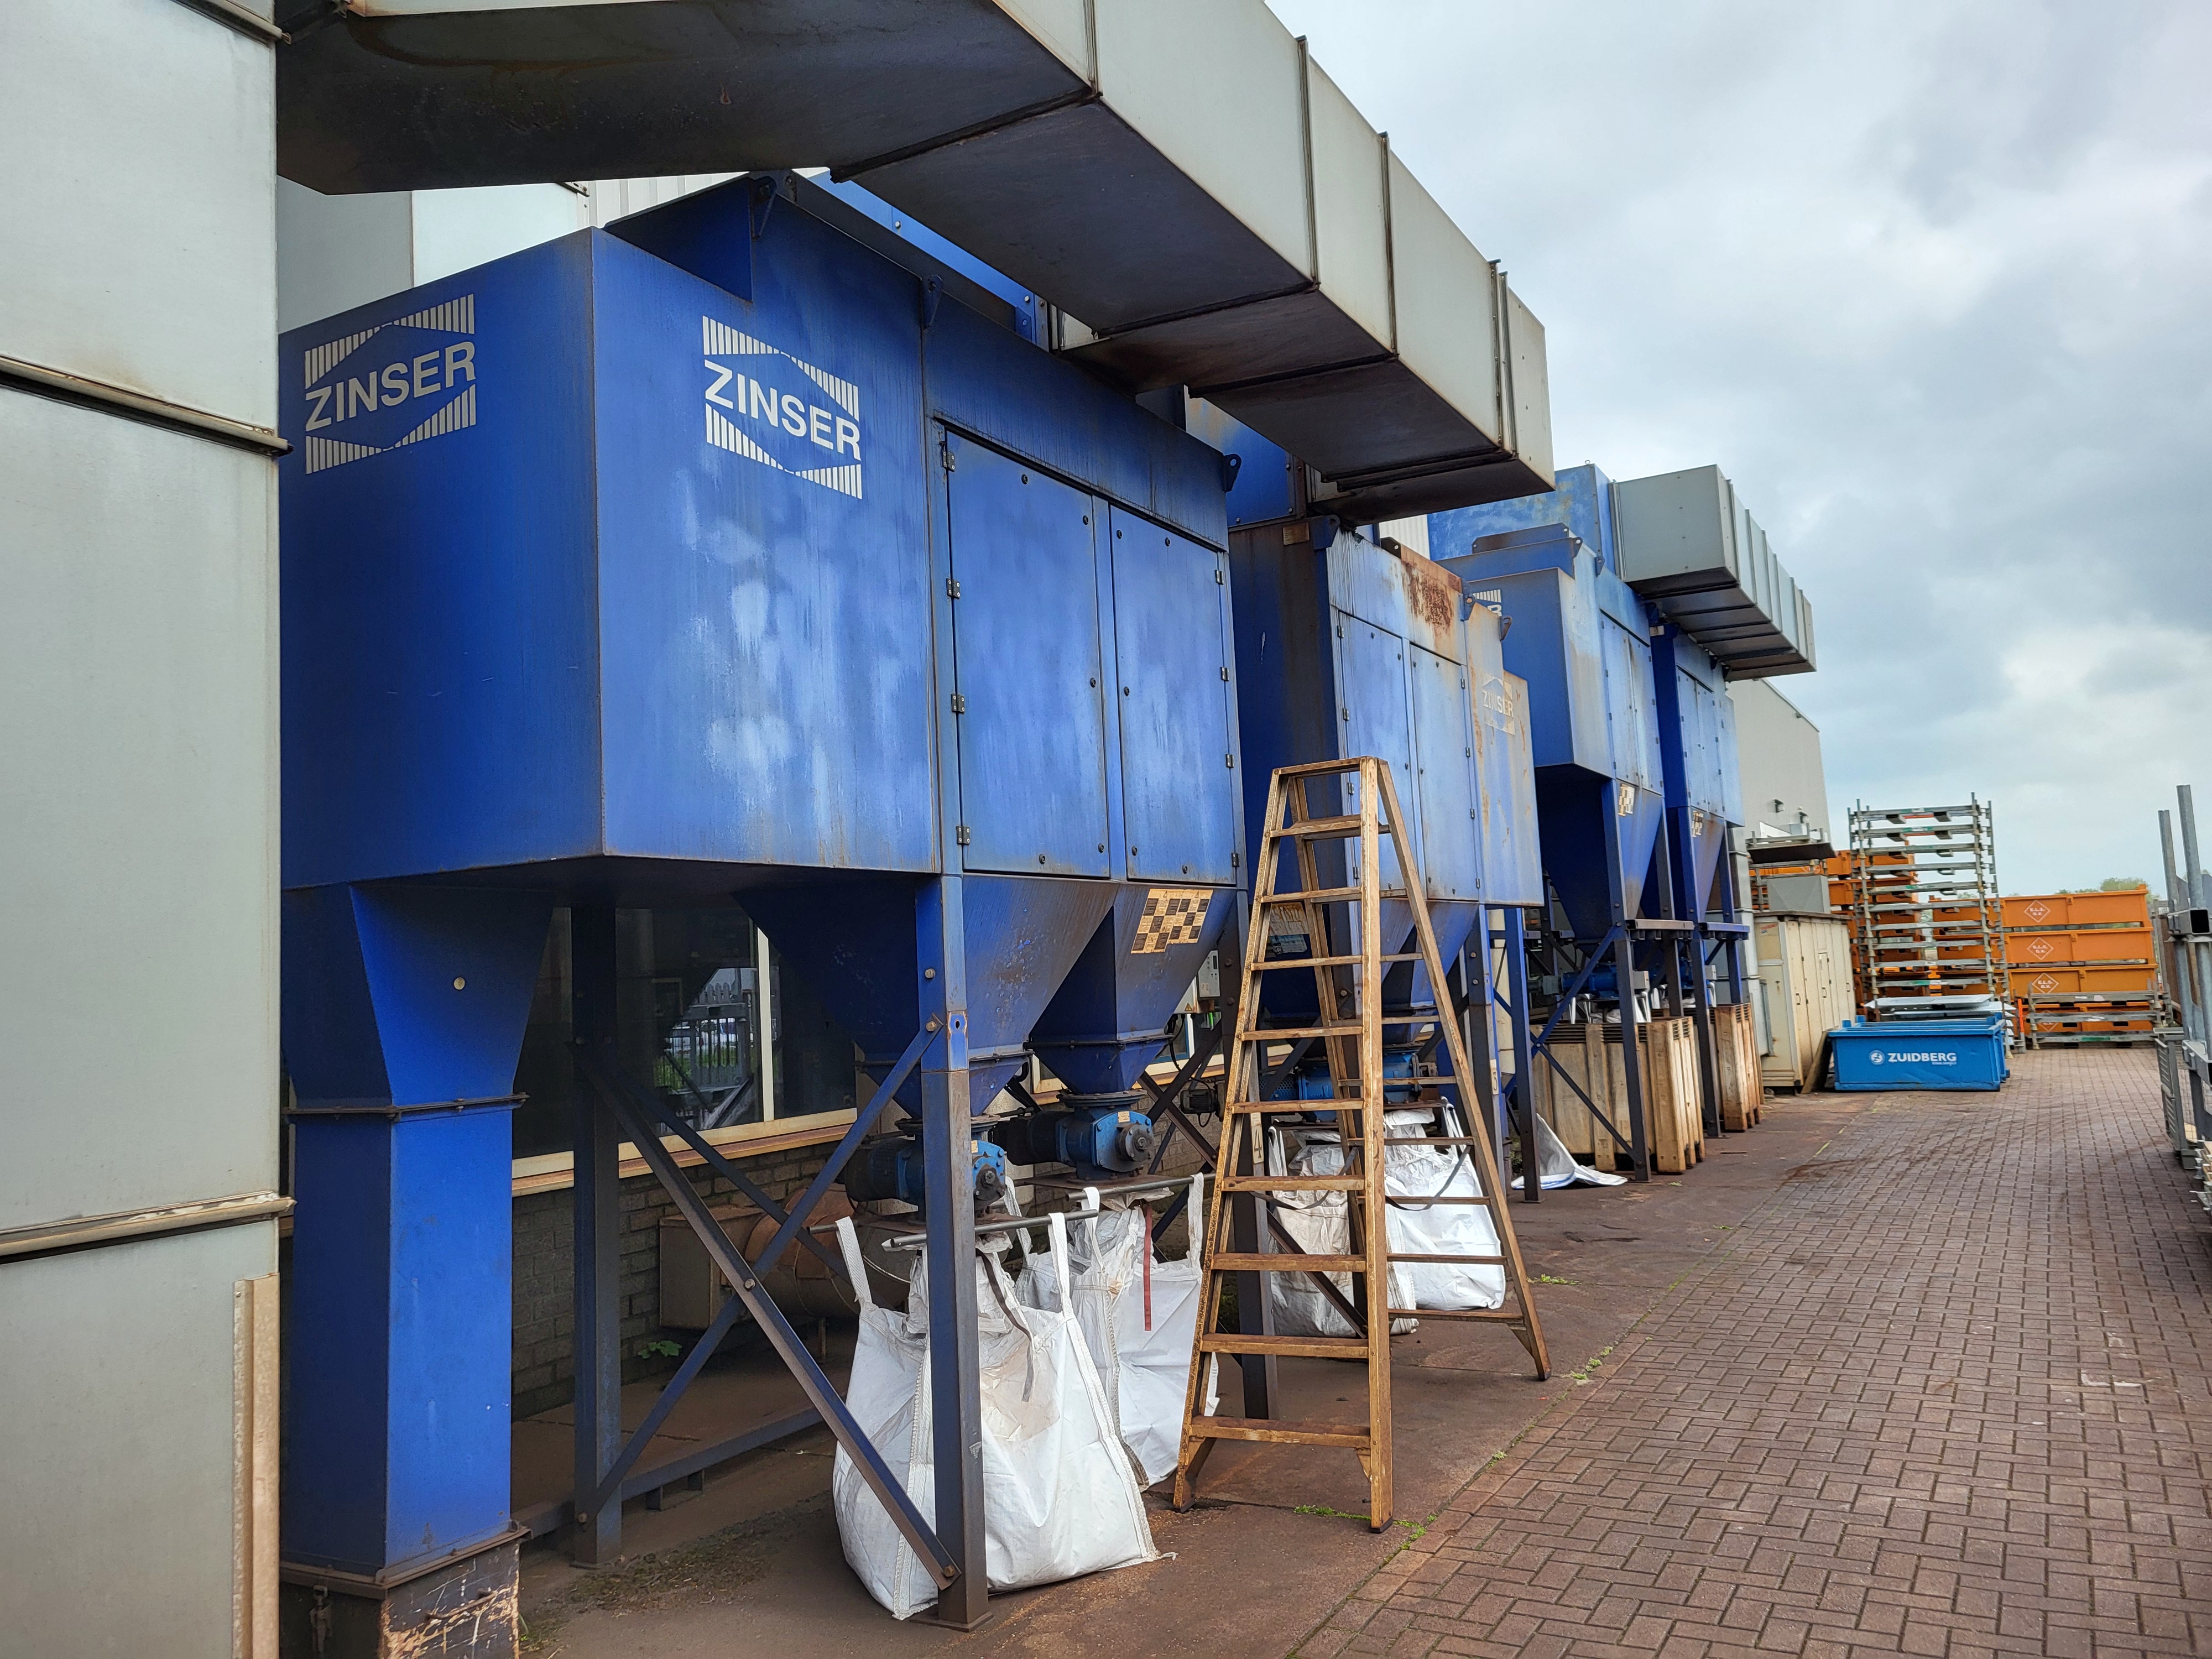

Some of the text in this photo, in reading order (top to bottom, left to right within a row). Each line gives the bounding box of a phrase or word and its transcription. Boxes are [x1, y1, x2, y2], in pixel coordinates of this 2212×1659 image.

[305, 341, 476, 431] ZINSER
[704, 359, 862, 461] ZINSER
[1887, 1052, 1957, 1062] ZUIDBERG
[1254, 1129, 1262, 1159] 4
